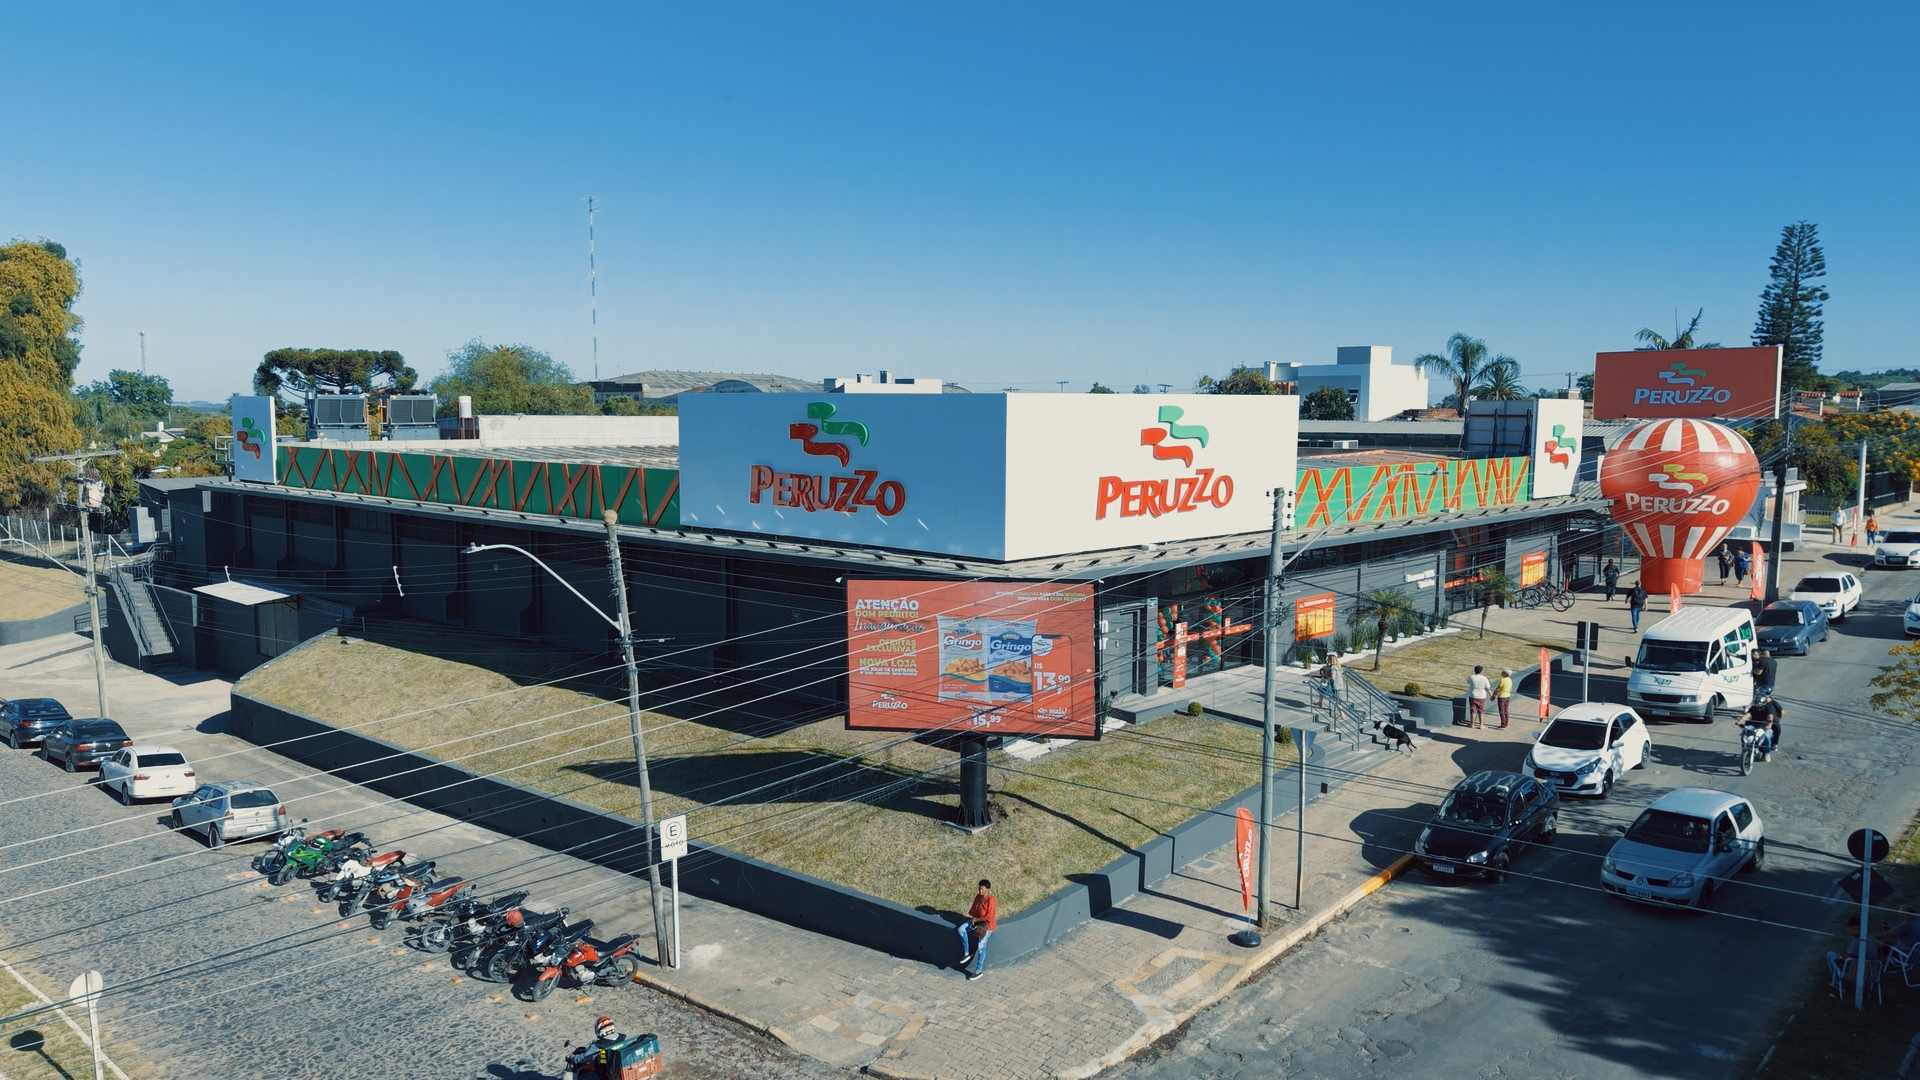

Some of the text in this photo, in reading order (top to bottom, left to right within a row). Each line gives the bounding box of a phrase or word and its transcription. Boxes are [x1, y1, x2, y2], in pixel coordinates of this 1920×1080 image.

[1633, 386, 1731, 405] PERUZZO
[749, 465, 906, 517] PERUZZO
[1096, 468, 1234, 520] PERUZZO
[1625, 492, 1730, 516] PERUZZO
[855, 597, 919, 612] ATENÇÃO
[855, 610, 919, 618] DOM PEDRITO!
[853, 616, 925, 635] Inauguração
[866, 645, 916, 653] EXCLUSIVAS
[879, 639, 916, 647] OFERTAS
[943, 636, 982, 650] Gringo
[990, 640, 1031, 654] Gringo
[859, 658, 917, 667] NOVA LOJA
[872, 700, 908, 709] PERUZZO
[669, 825, 677, 837] E
[665, 840, 684, 849] MOTO
